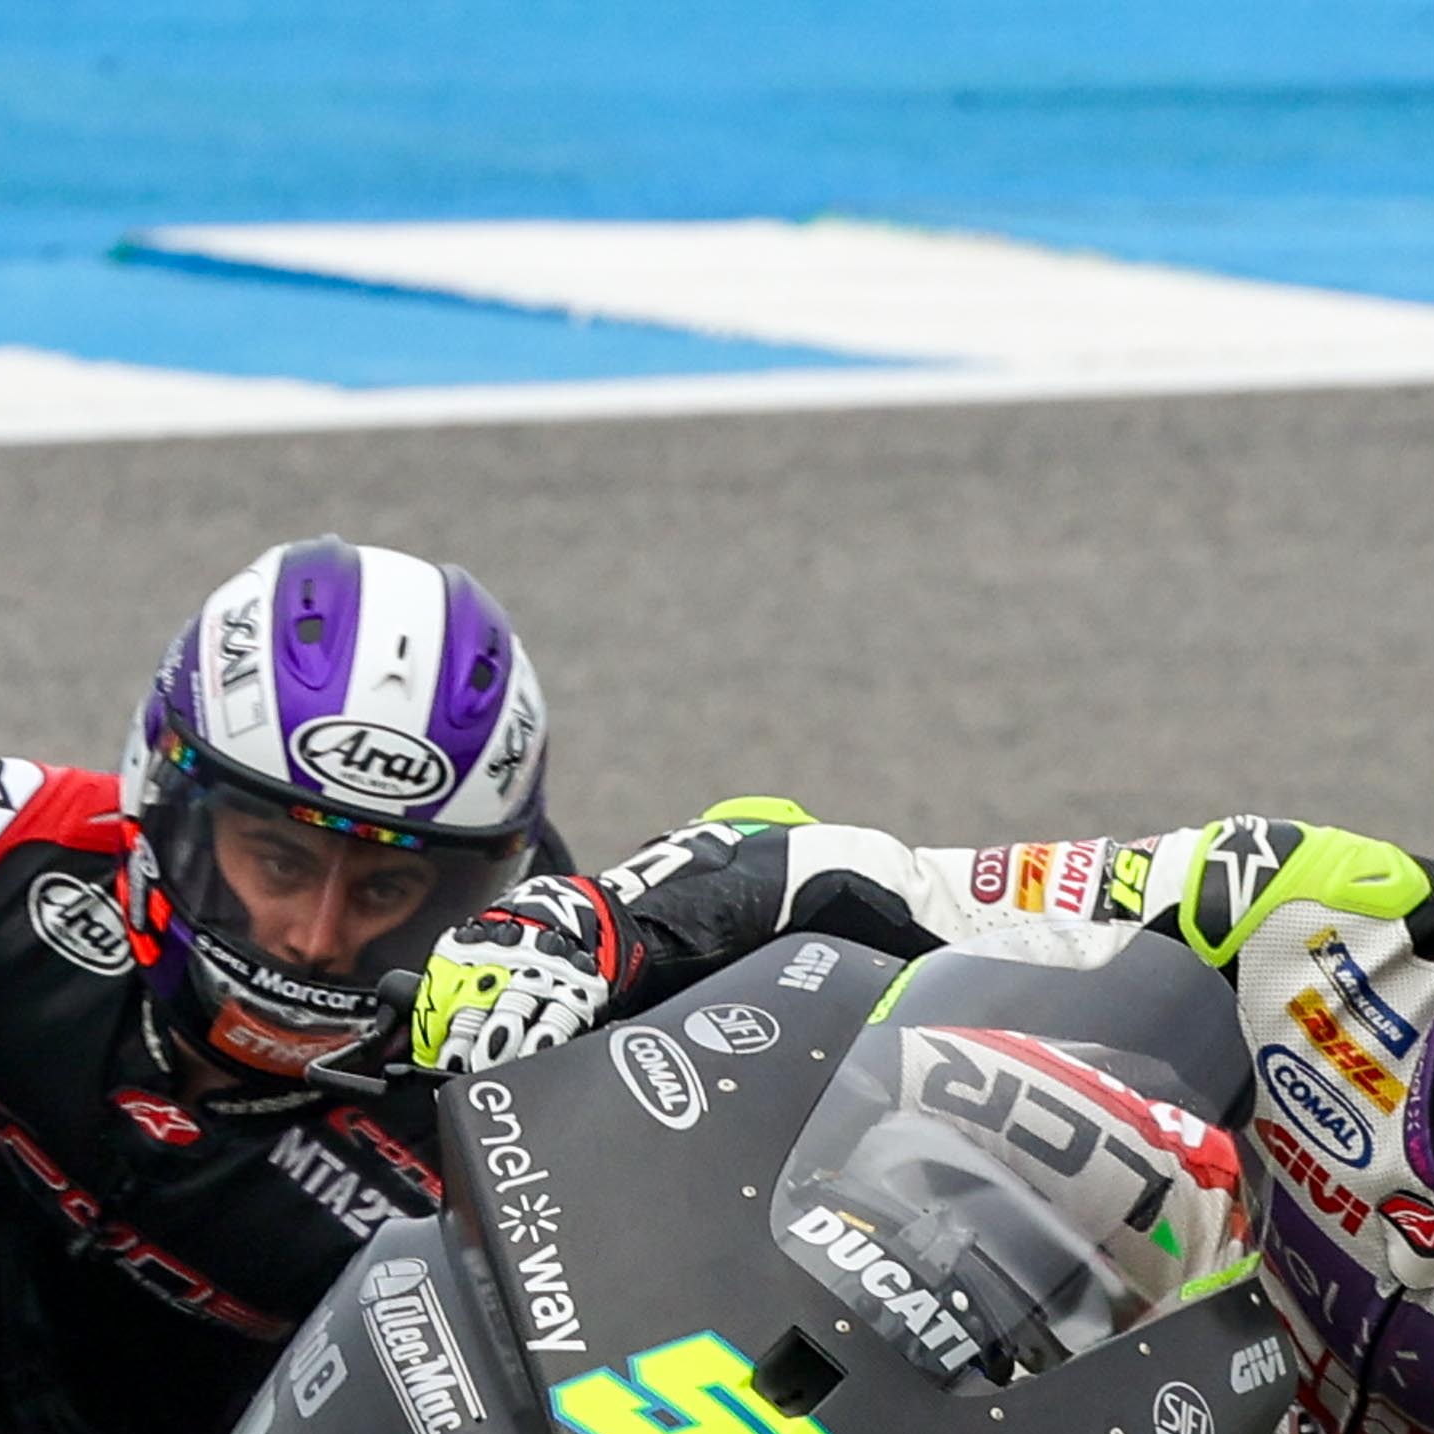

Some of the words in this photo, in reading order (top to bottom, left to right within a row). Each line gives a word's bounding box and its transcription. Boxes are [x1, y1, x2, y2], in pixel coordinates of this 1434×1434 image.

[304, 729, 438, 786] Arai
[1110, 848, 1150, 916] 51
[714, 1006, 771, 1052] SIFI
[1301, 1005, 1393, 1099] DHL
[627, 1036, 689, 1111] COMAL
[1273, 1064, 1358, 1152] COMAL
[469, 1081, 550, 1193] enel
[519, 1245, 587, 1353] way
[1254, 1117, 1374, 1238] GIVI
[786, 1205, 983, 1371] DUCATI
[1231, 1336, 1288, 1395] GIVI
